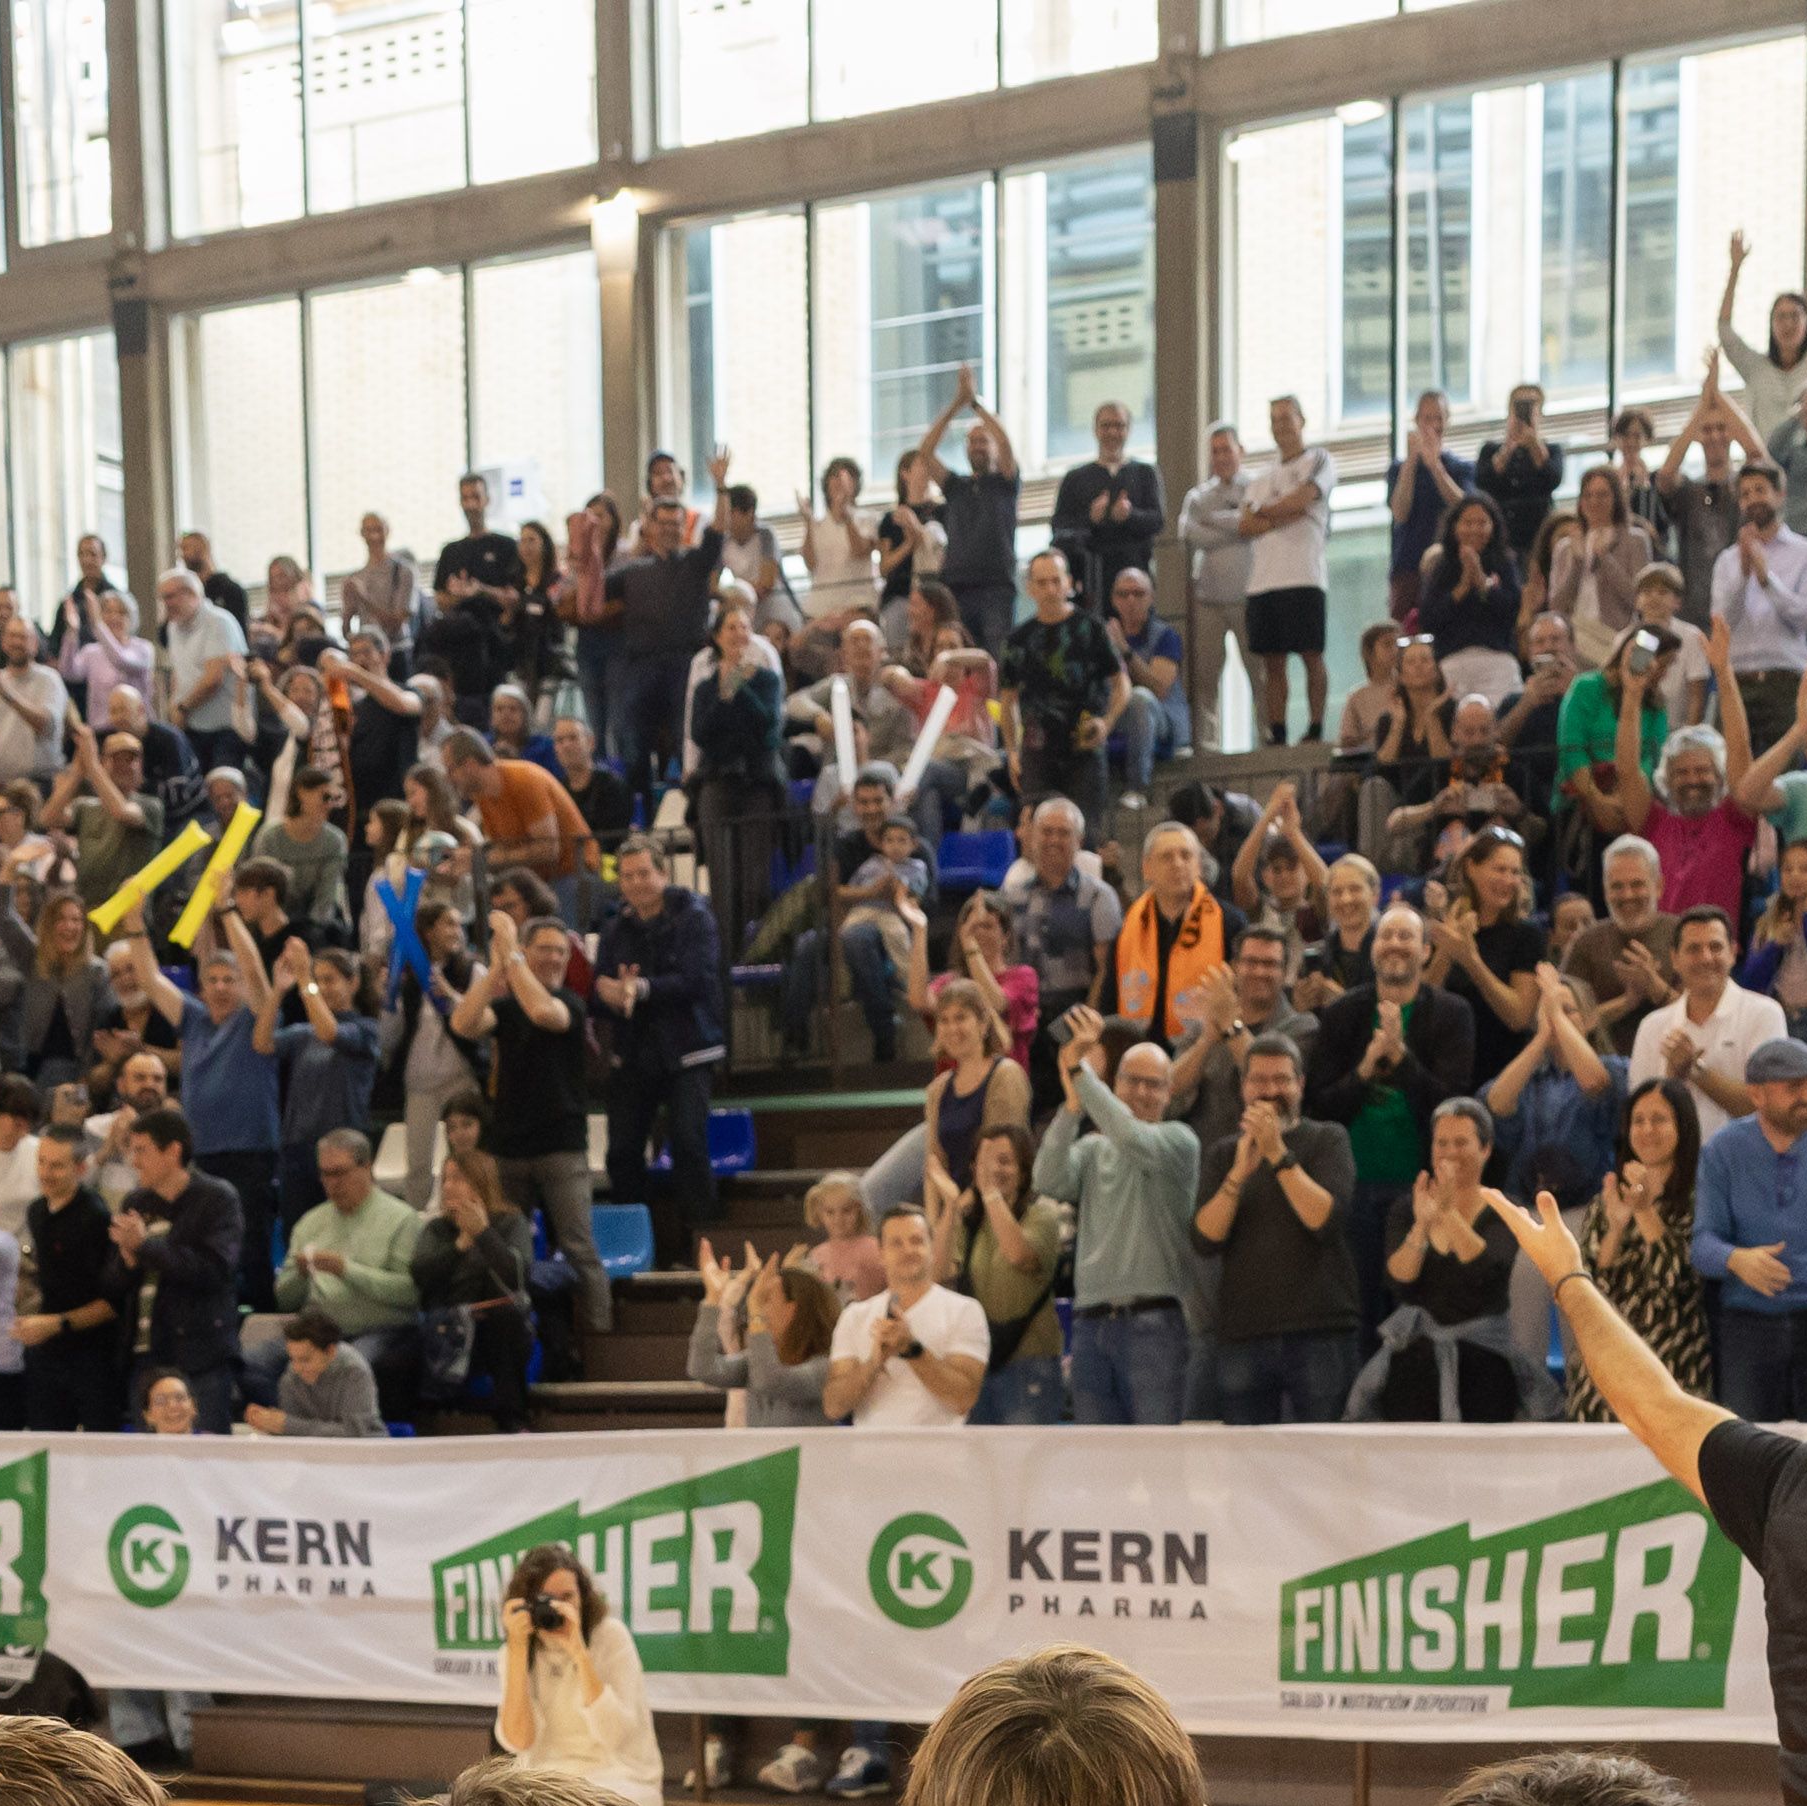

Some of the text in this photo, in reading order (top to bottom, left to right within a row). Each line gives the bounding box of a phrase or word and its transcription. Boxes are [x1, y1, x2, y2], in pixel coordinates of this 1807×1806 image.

[216, 1516, 372, 1567] KERN
[1008, 1527, 1208, 1586] KERN
[216, 1575, 376, 1597] PHARMA
[443, 1499, 764, 1641] FINHER
[1295, 1511, 1708, 1673] FINISHER
[1008, 1595, 1209, 1621] PHARMA
